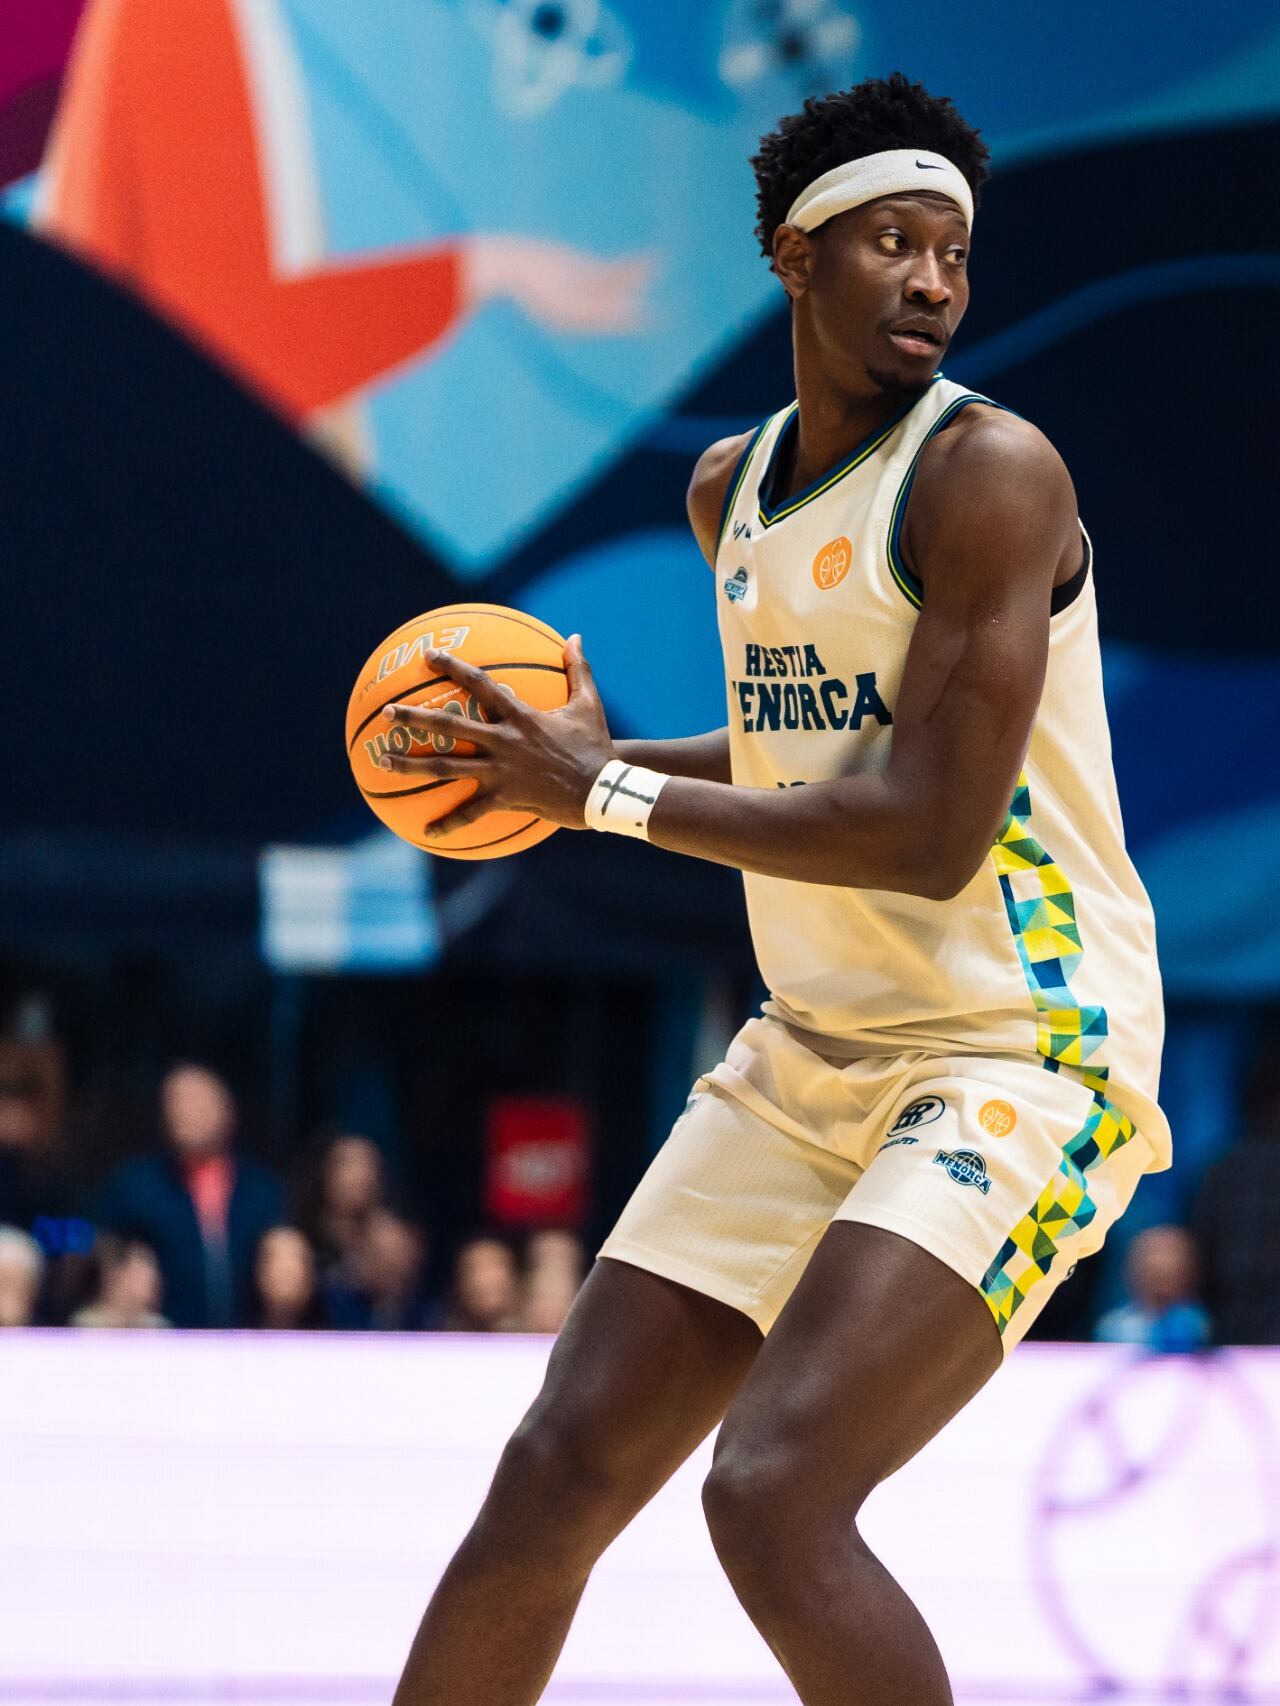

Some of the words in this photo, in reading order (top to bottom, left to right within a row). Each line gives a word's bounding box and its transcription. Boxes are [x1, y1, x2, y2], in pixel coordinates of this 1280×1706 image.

[745, 643, 827, 678] HESTIA
[732, 671, 893, 733] ENORCA
[936, 1153, 991, 1192] MENORCA
